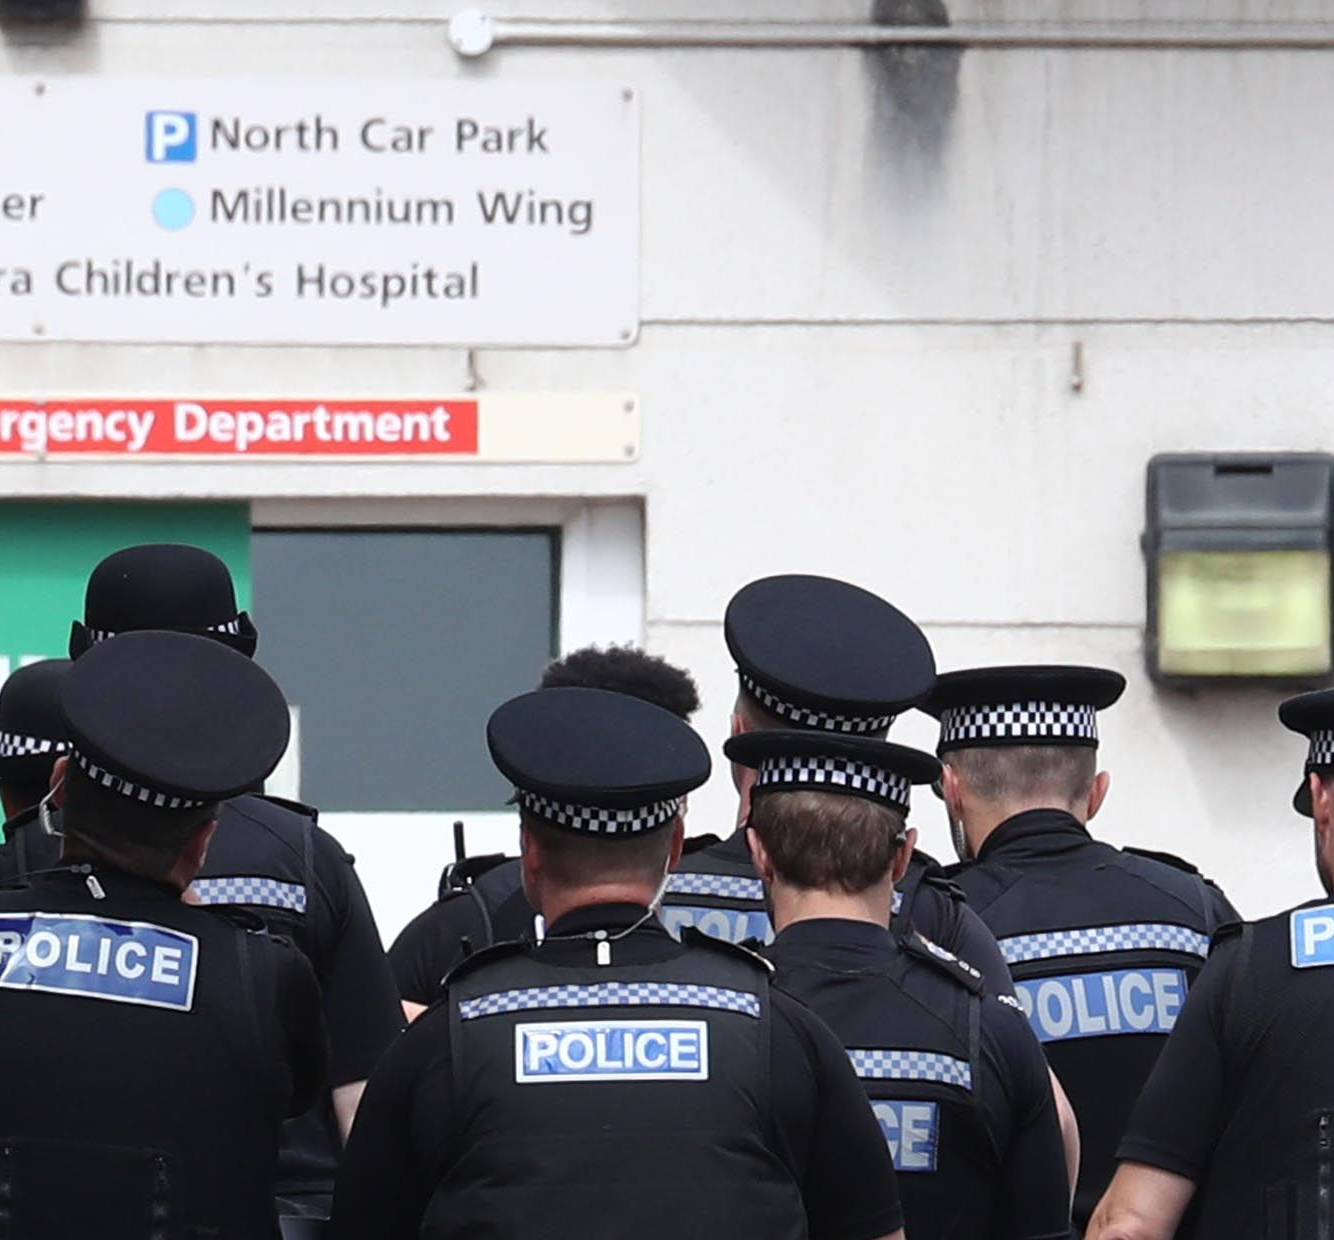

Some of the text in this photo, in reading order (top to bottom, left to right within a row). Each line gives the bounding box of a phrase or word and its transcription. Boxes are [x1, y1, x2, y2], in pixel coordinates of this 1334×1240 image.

[210, 116, 339, 152] North
[359, 118, 430, 152] Car
[455, 117, 547, 153] Park
[210, 187, 593, 236] Millennium Wing
[54, 260, 274, 298] Children's
[296, 262, 478, 305] Hospital
[174, 404, 450, 452] Department
[528, 1031, 700, 1072] POLICE
